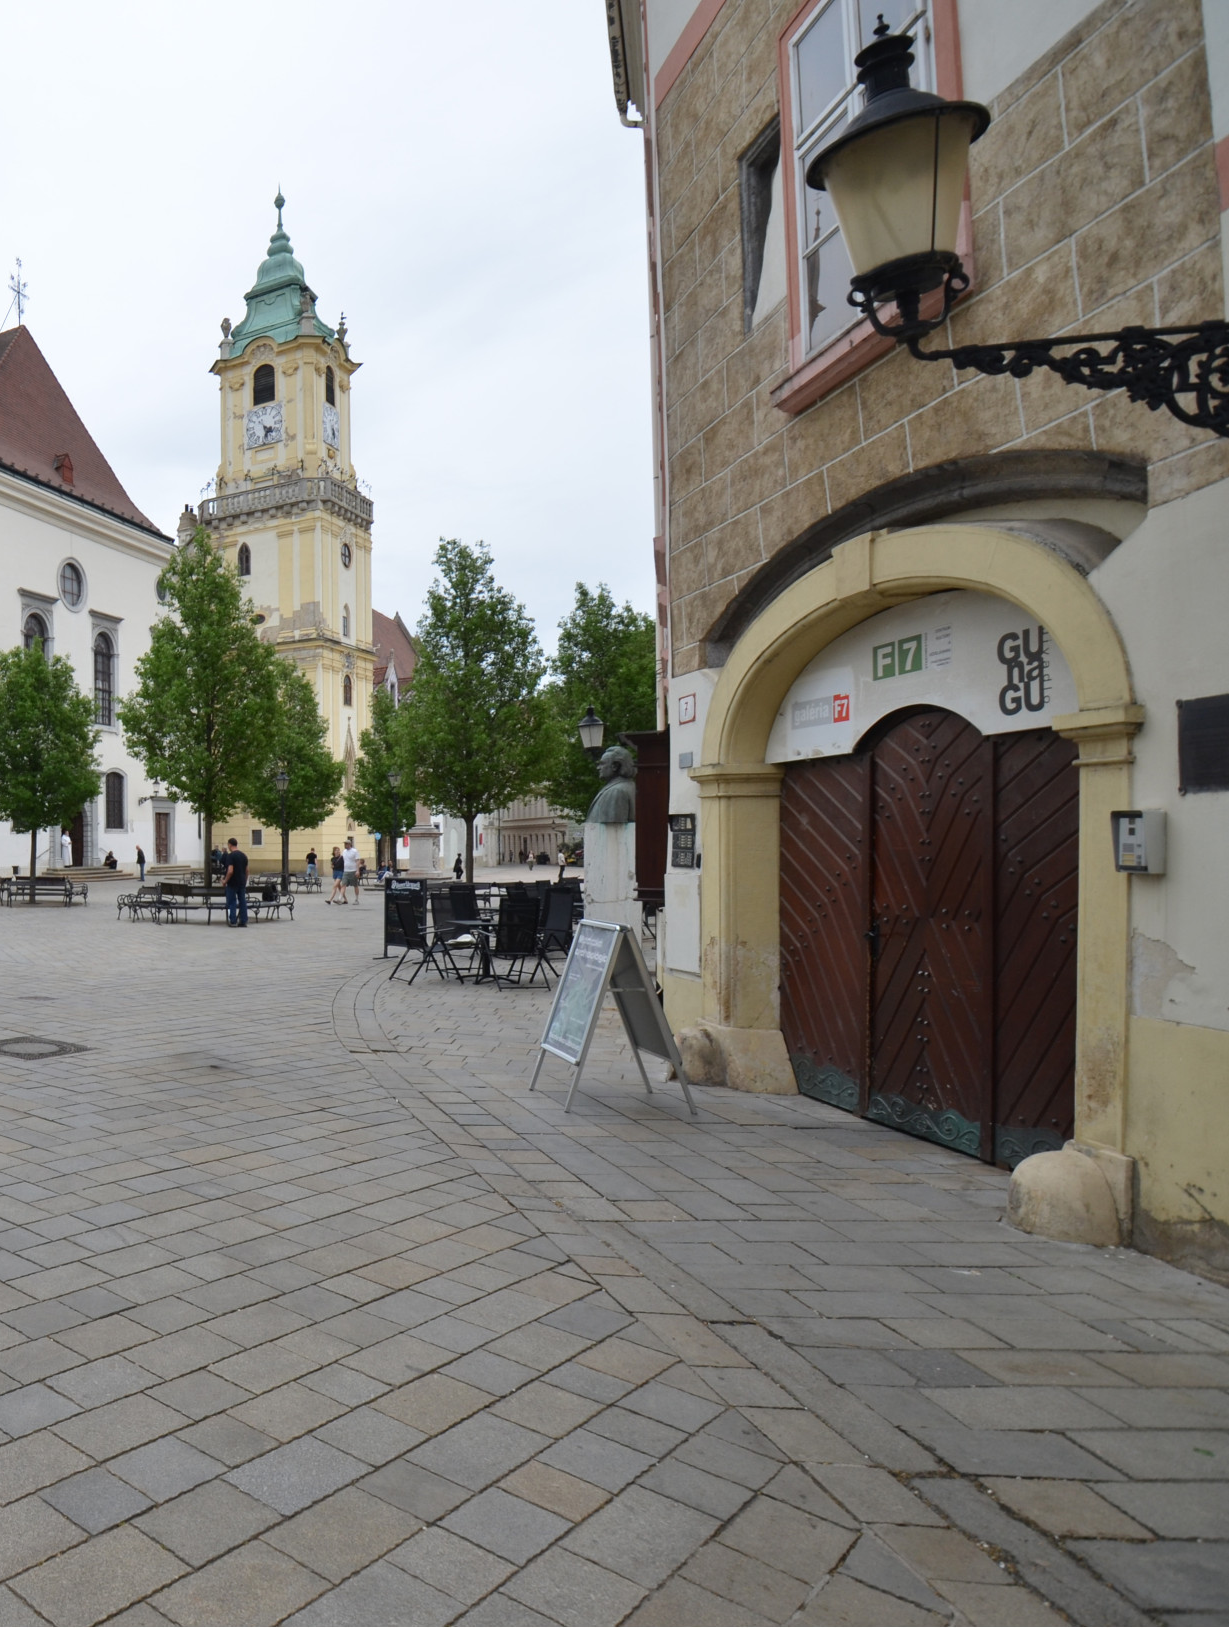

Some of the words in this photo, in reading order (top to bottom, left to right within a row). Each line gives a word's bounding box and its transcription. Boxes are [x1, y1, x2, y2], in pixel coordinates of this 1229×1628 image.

[684, 701, 689, 717] 7
[794, 701, 830, 726] galéria
[834, 698, 849, 719] F7
